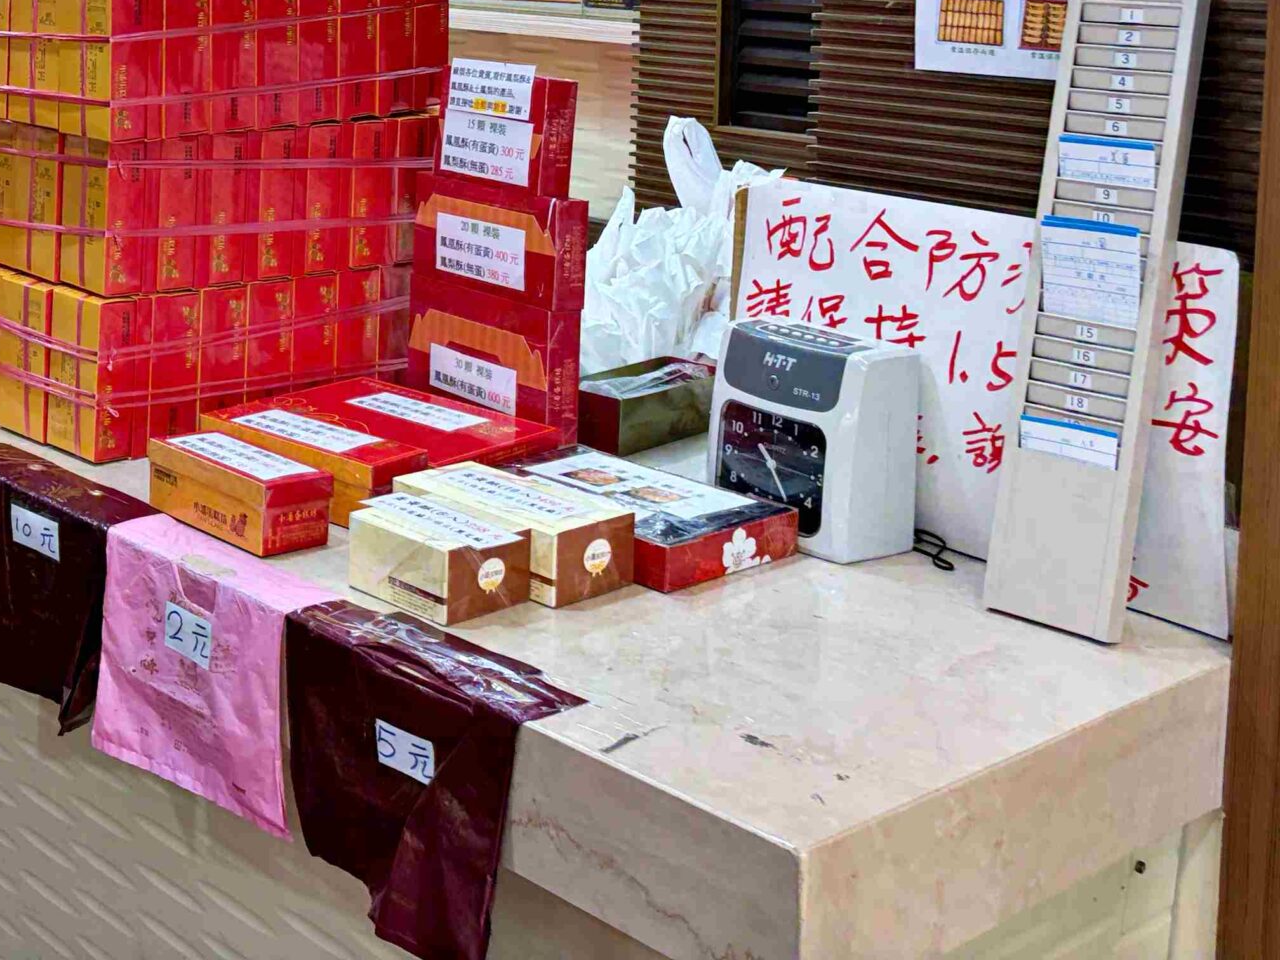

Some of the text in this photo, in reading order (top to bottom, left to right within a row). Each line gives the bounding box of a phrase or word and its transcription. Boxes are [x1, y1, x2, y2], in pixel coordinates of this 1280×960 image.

[1129, 10, 1134, 20] 1
[1125, 31, 1133, 42] 2
[1121, 53, 1130, 64] 3
[1118, 76, 1126, 87] 4
[1115, 99, 1123, 110] 5
[467, 120, 475, 129] 15
[489, 122, 506, 136] 裸裝
[1111, 122, 1120, 133] 6
[500, 146, 514, 158] 300
[515, 148, 525, 161] 元
[490, 165, 503, 176] 285
[504, 168, 514, 180] 元
[1102, 189, 1110, 200] 9
[461, 221, 470, 232] 20
[483, 225, 500, 240] 裸裝
[494, 250, 508, 263] 400
[509, 253, 519, 266] 元
[487, 269, 500, 281] 380
[501, 272, 511, 284] 元
[1079, 326, 1094, 339] 15
[1076, 350, 1091, 362] 16
[1073, 372, 1087, 384] 17
[793, 387, 820, 401] STR-13
[502, 395, 512, 409] 元
[1070, 395, 1084, 409] 18
[752, 411, 799, 435] 11 12 1
[732, 420, 818, 458] 10 2
[725, 444, 733, 455] 9
[730, 470, 823, 486] 8 3
[804, 497, 813, 508] 4
